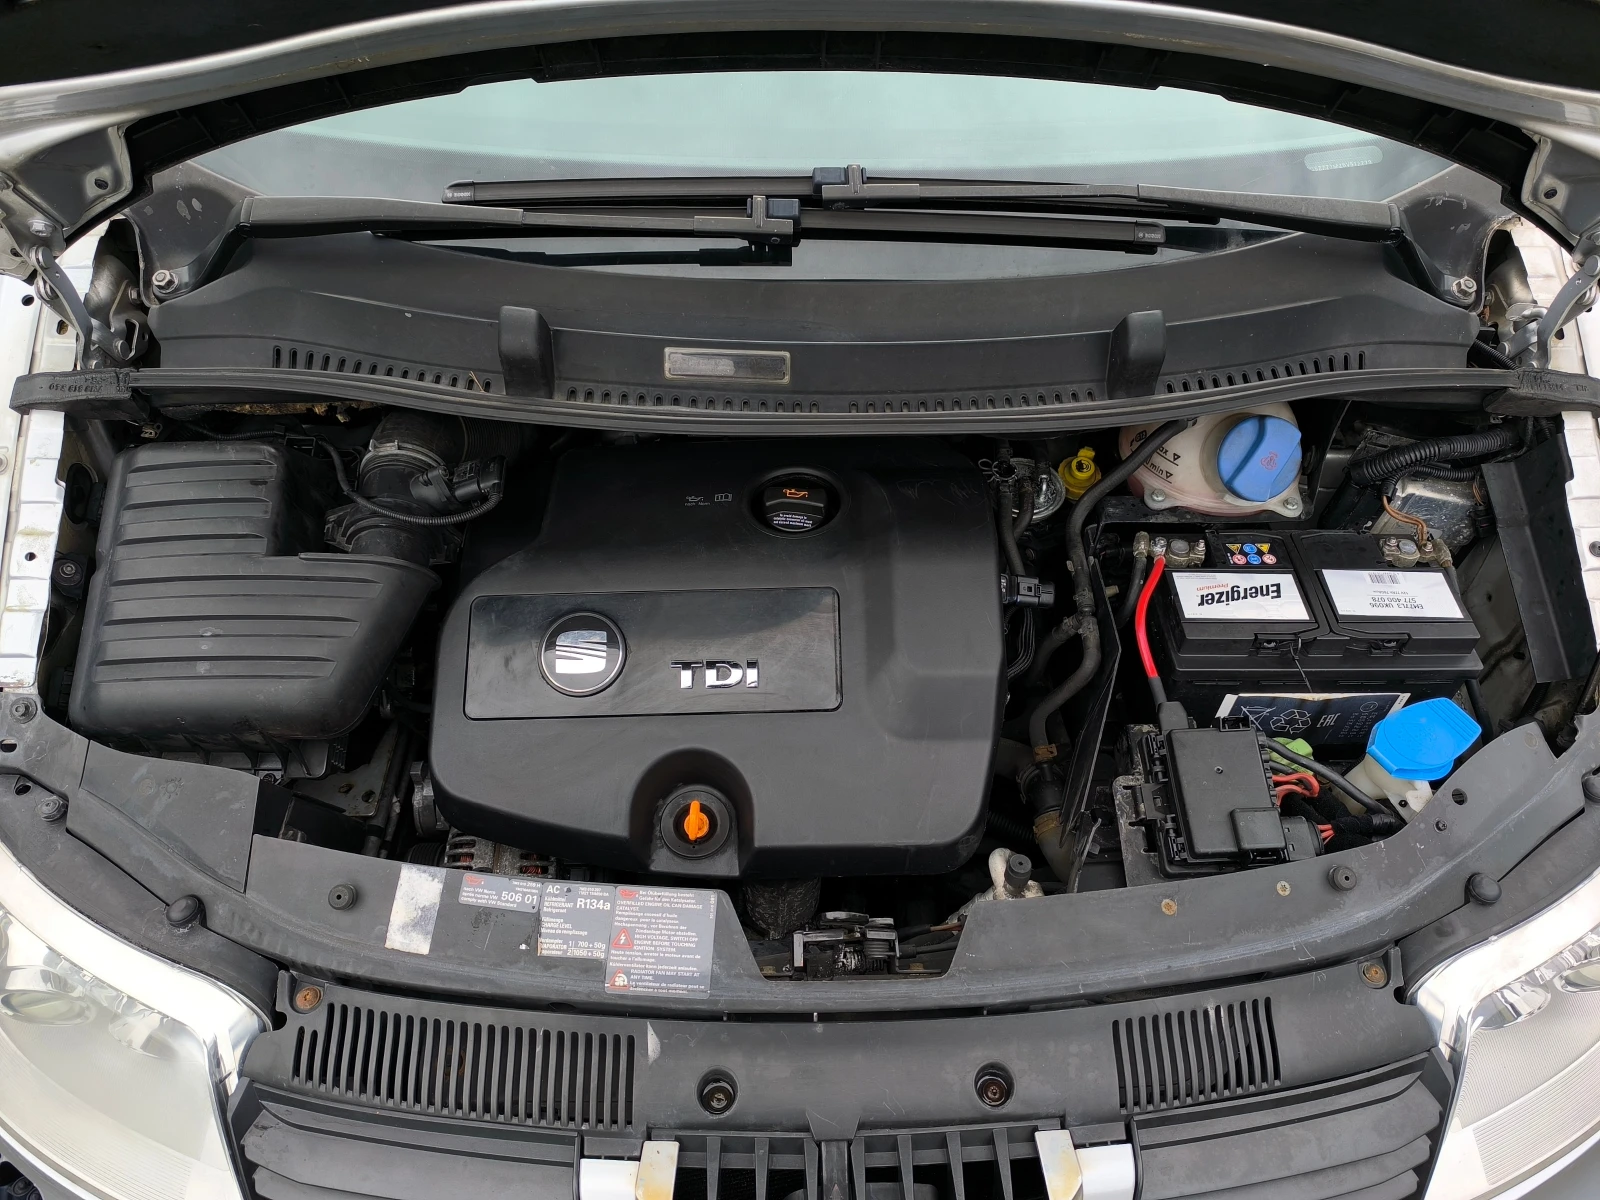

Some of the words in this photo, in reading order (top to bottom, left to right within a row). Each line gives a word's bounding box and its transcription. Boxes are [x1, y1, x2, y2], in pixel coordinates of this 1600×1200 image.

[1196, 583, 1228, 592] Premium
[1198, 583, 1282, 606] Energizer
[671, 659, 759, 689] TDI
[546, 885, 560, 894] AC
[501, 891, 522, 902] 506
[525, 895, 537, 904] 01
[576, 898, 610, 910] R134a
